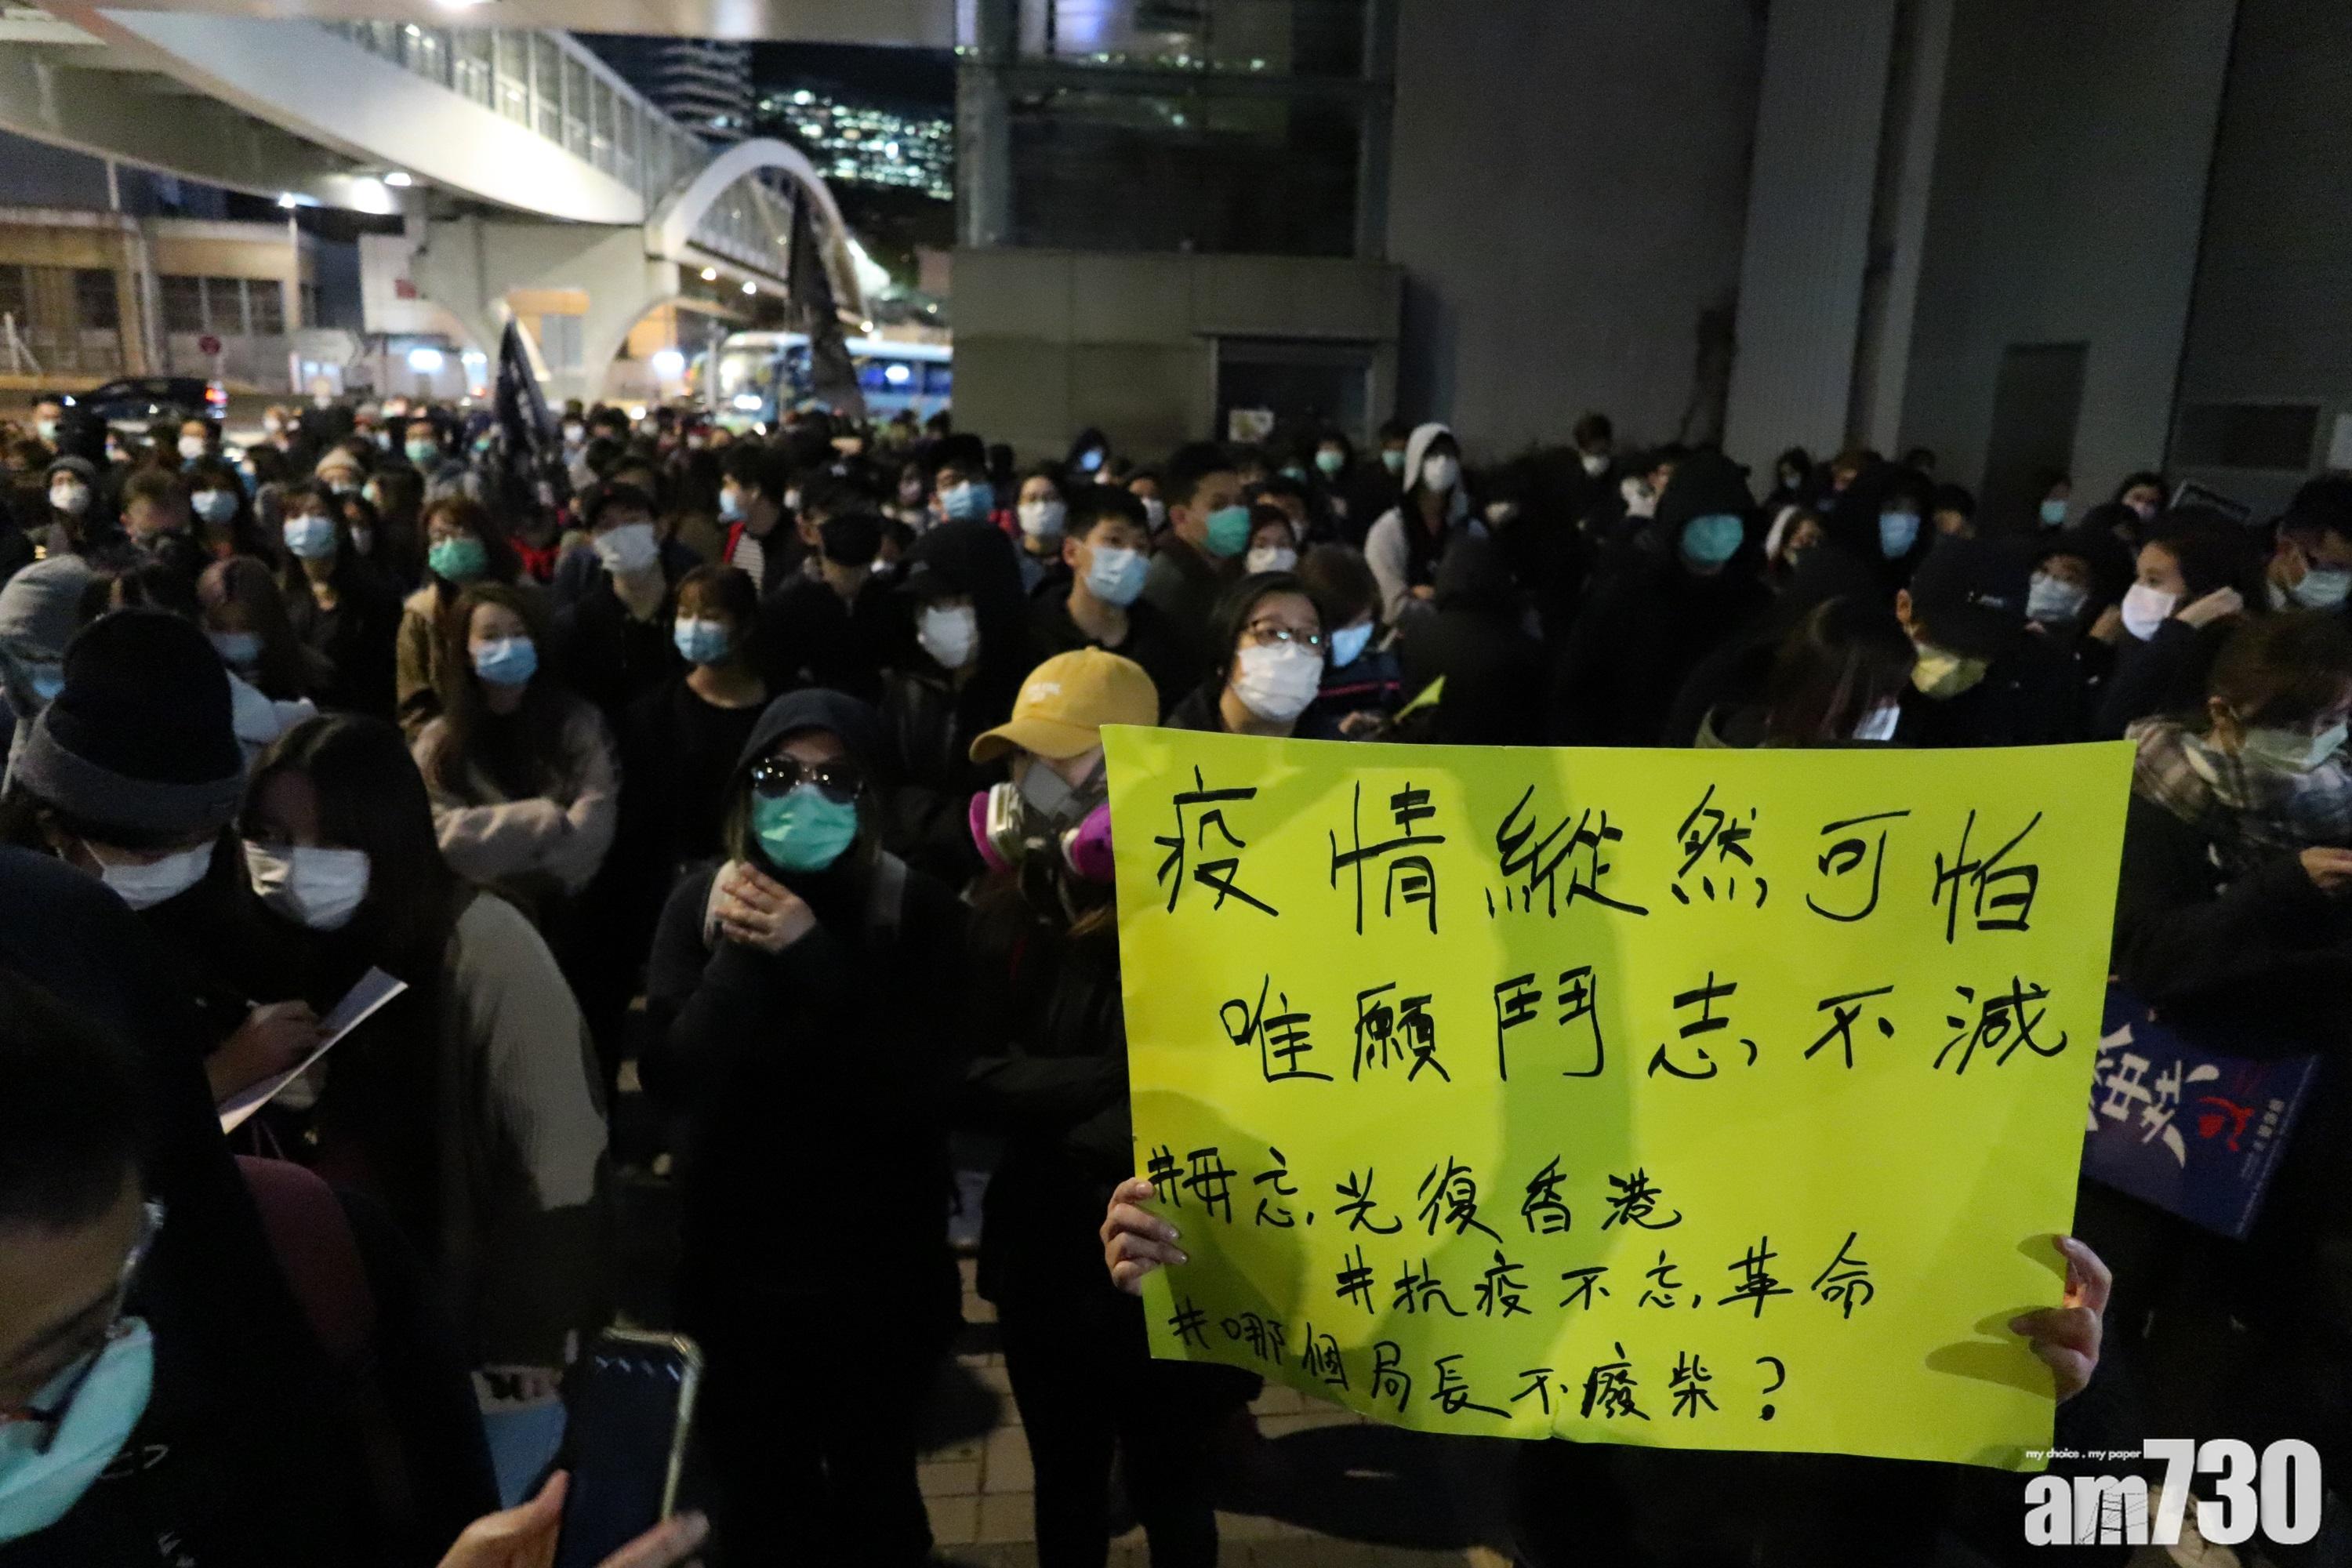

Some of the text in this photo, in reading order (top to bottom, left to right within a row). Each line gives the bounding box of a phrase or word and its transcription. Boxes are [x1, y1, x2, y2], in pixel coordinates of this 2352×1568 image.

[1154, 764, 2042, 945] 疫情縱然可怕
[1335, 1232, 1875, 1319] #抗疫不忘革命
